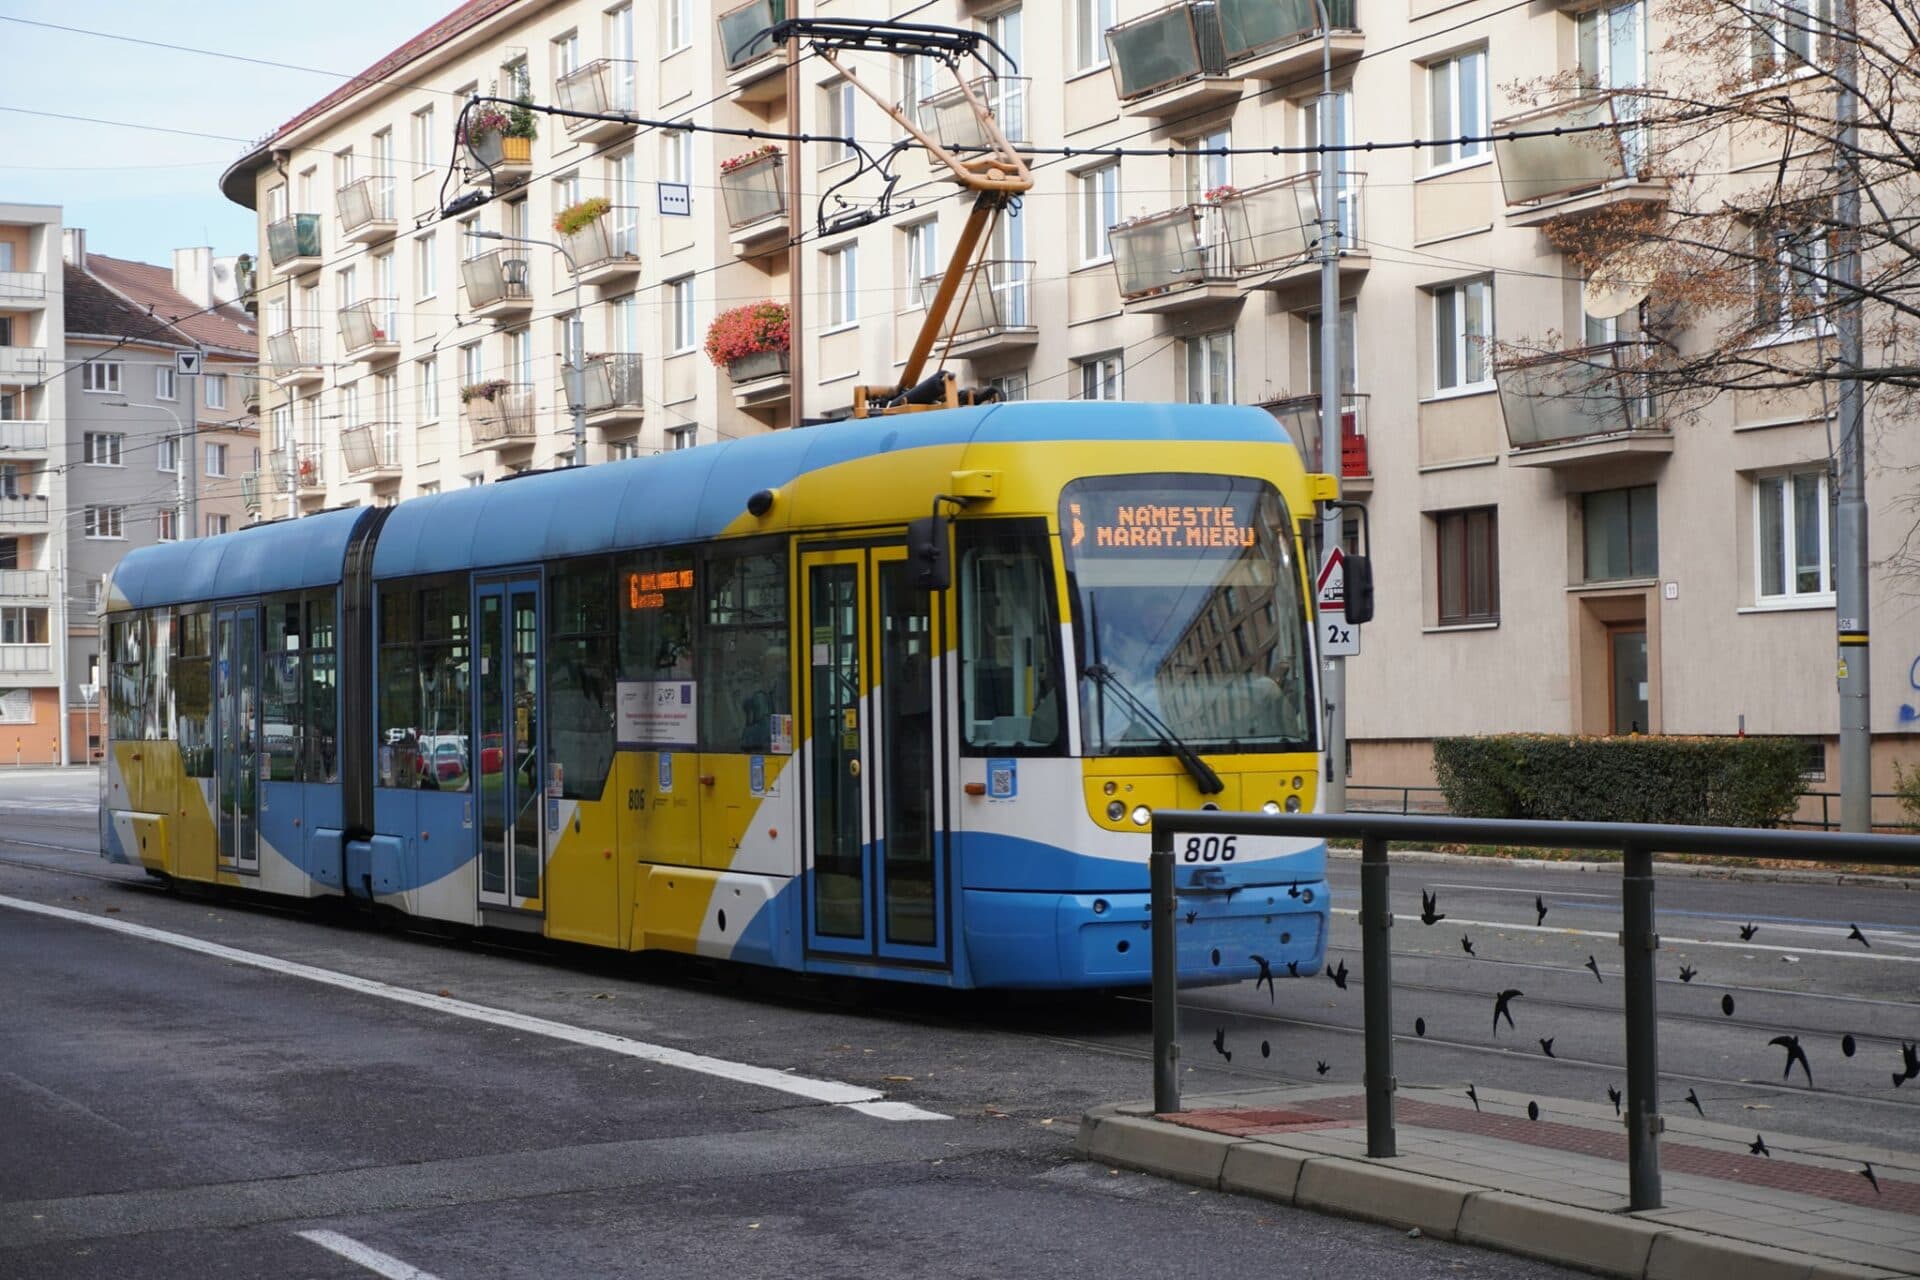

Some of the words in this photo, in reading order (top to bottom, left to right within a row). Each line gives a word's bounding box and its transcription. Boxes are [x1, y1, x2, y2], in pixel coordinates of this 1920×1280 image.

[1328, 624, 1350, 644] 2x
[628, 788, 646, 811] 806
[1184, 835, 1238, 863] 806
